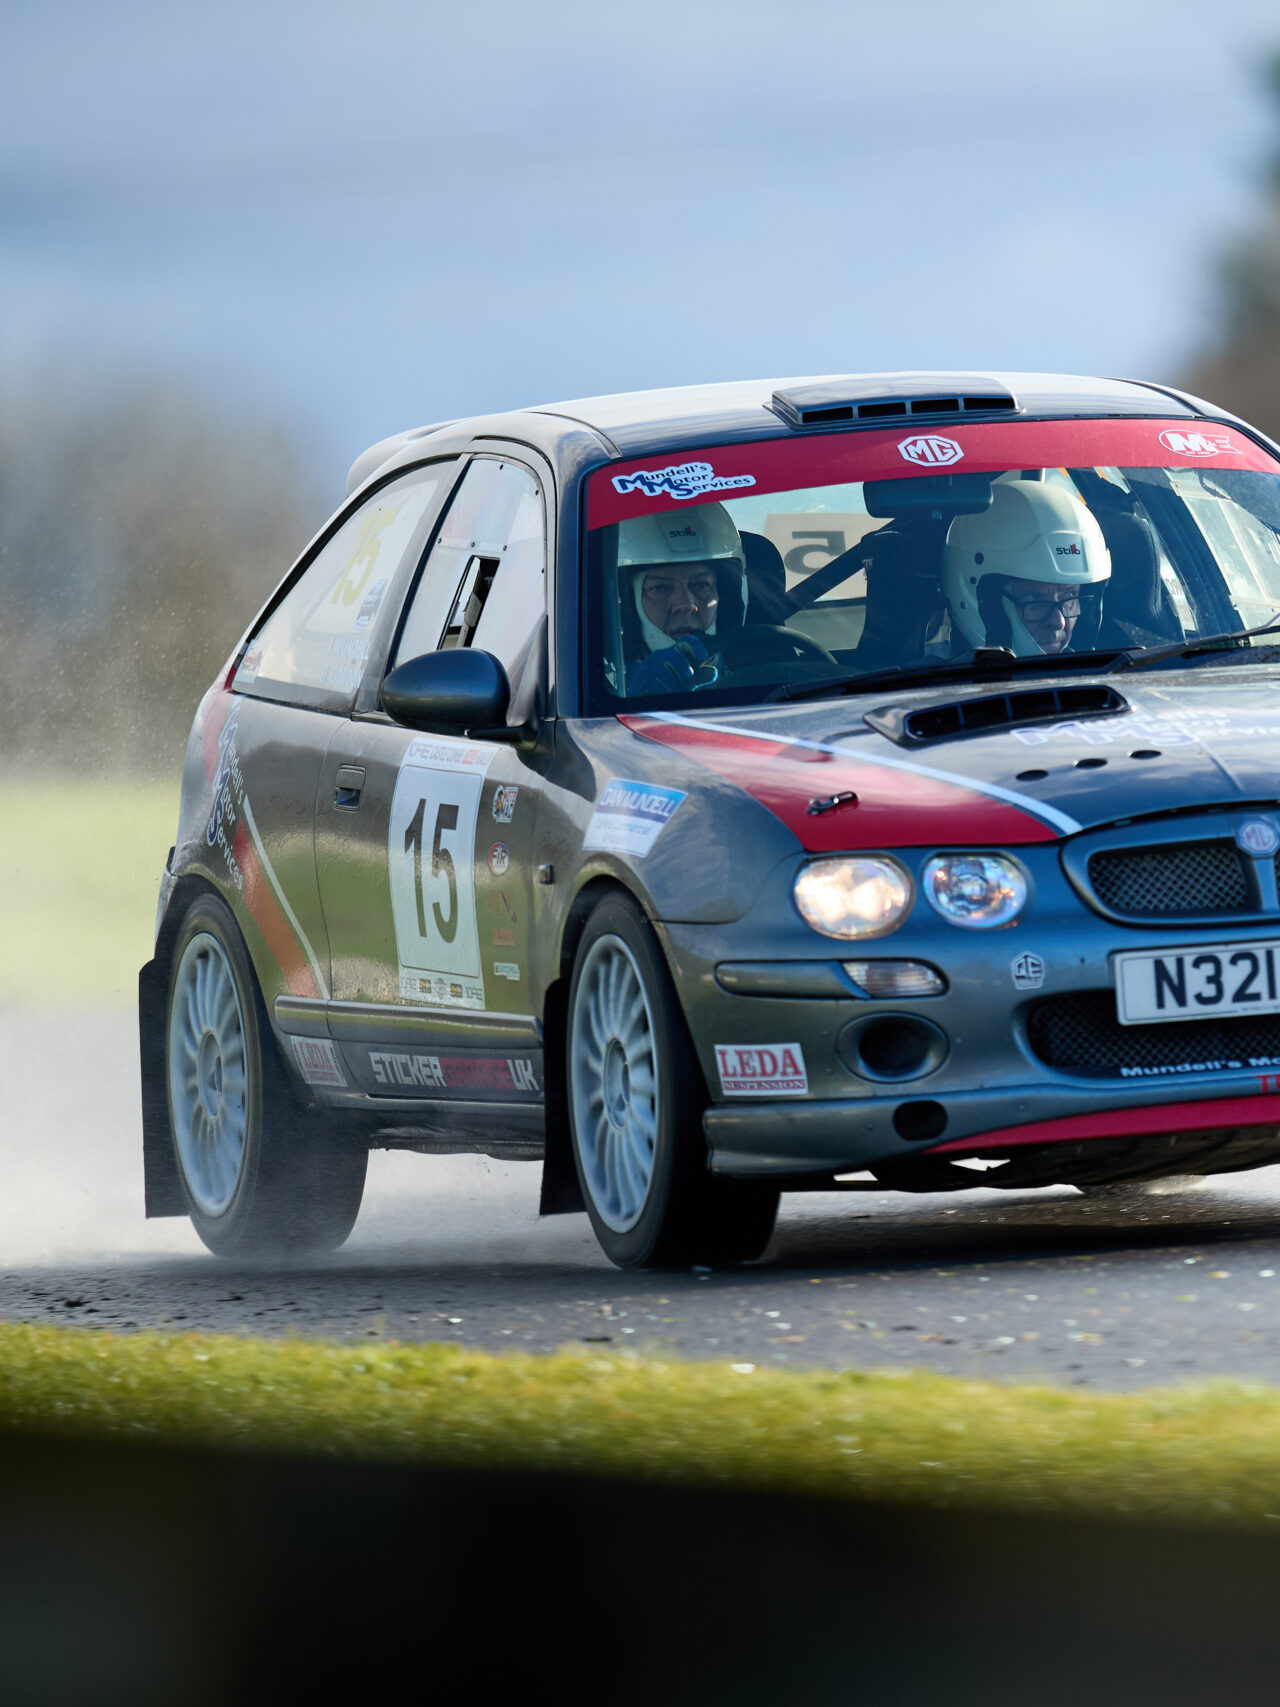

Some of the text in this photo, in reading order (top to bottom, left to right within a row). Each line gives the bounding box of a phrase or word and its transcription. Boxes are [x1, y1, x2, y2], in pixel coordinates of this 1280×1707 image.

[903, 437, 958, 463] MG
[618, 464, 708, 491] Mundell's
[645, 474, 709, 493] Motor
[673, 477, 751, 497] Services
[331, 508, 400, 607] 15
[1055, 543, 1081, 555] Stilo
[207, 799, 243, 891] Services
[404, 798, 460, 944] 15
[1153, 949, 1278, 1010] N321
[718, 1048, 803, 1077] LEDA
[1120, 1057, 1243, 1078] Mundell's
[723, 1080, 805, 1090] SUSPENSION
